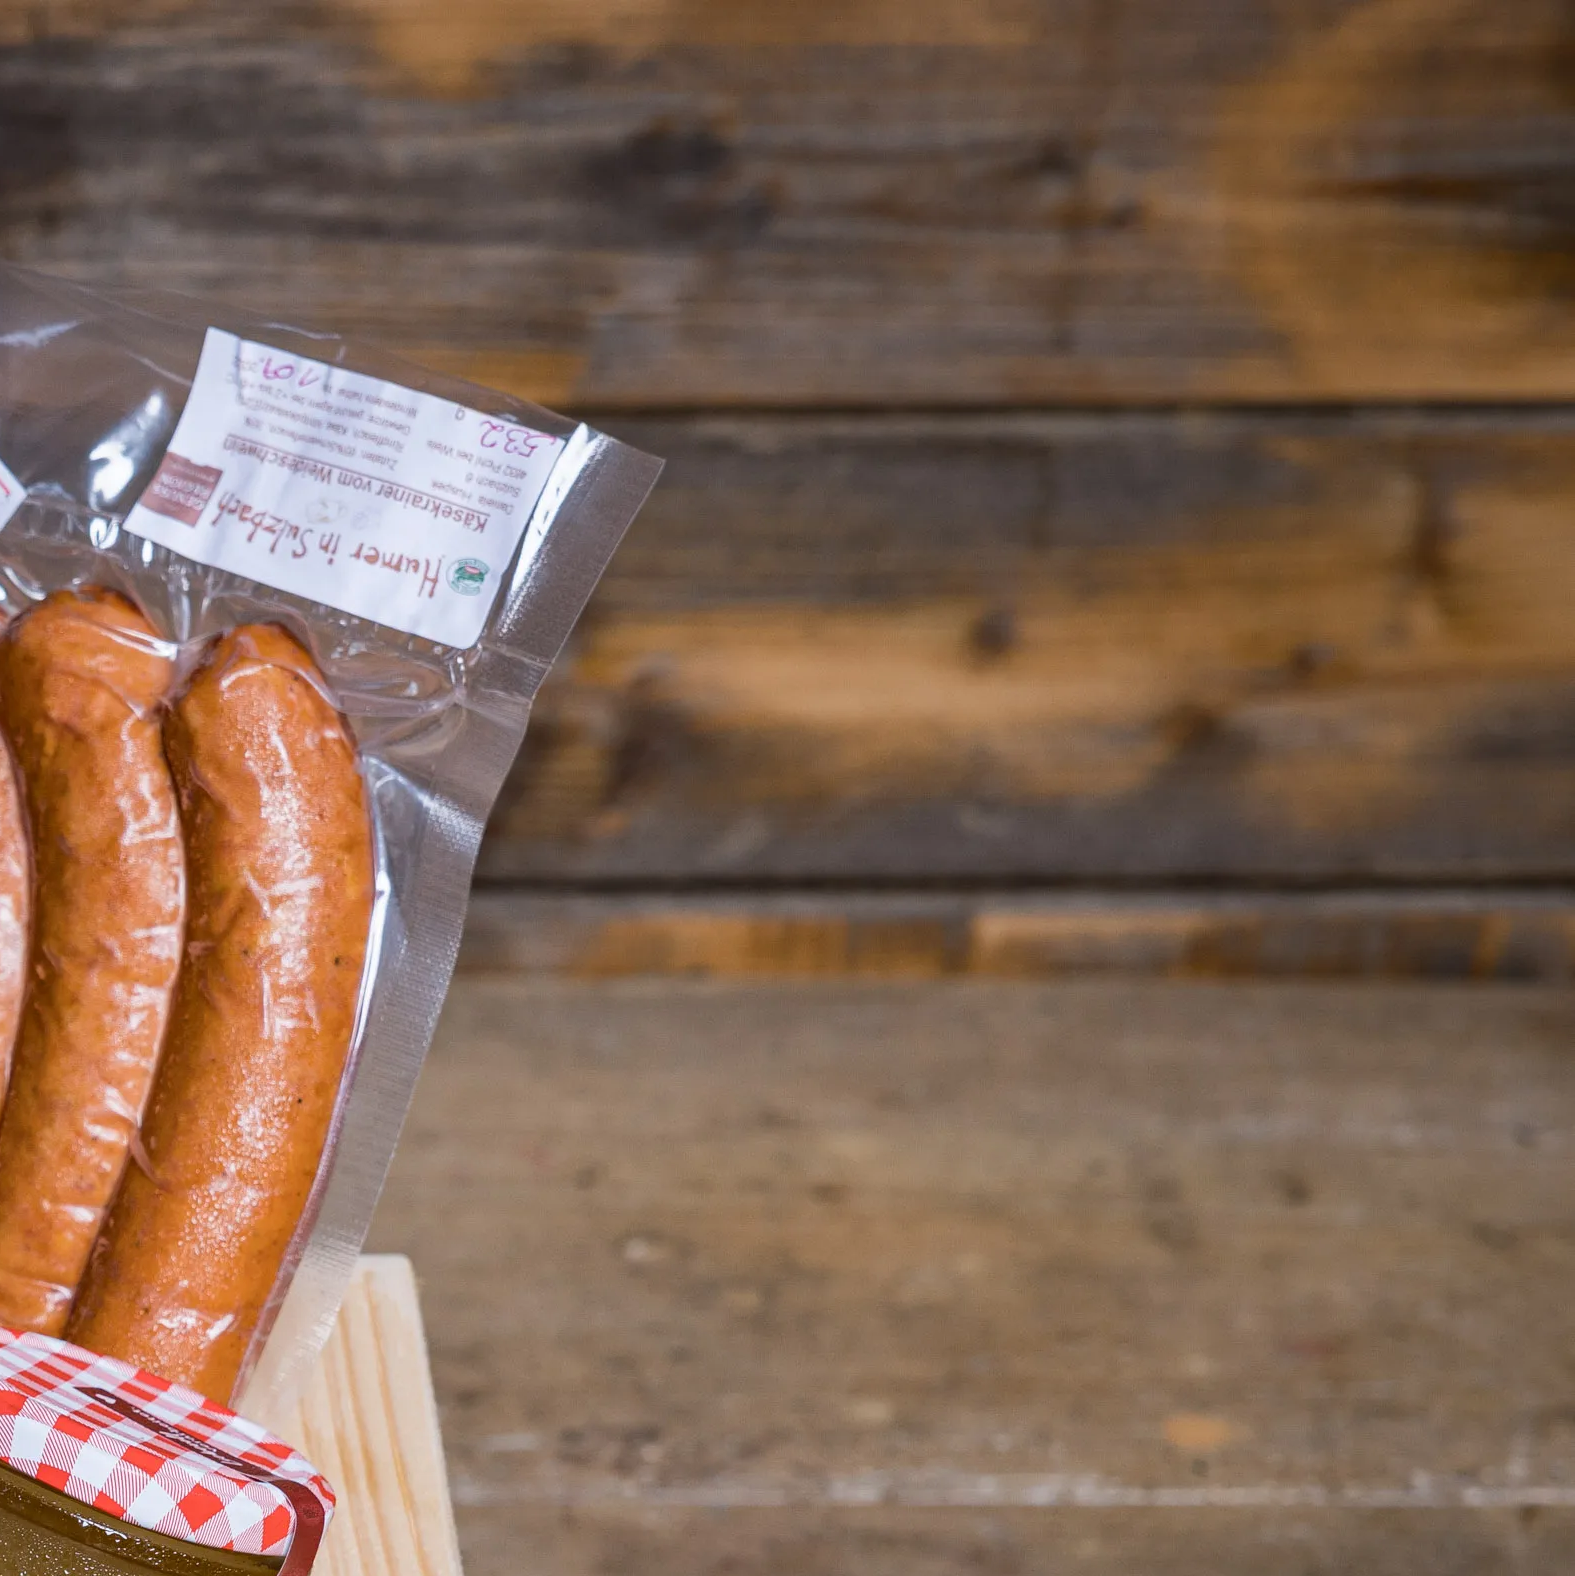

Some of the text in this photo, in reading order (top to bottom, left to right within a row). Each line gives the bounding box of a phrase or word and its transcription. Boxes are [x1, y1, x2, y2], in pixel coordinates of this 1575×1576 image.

[220, 435, 333, 484] Weideschwein
[335, 470, 372, 495] vom
[211, 490, 311, 560] Sulzbach
[373, 481, 488, 534] Käsekrainer
[314, 529, 340, 564] in
[348, 540, 443, 599] Humer
